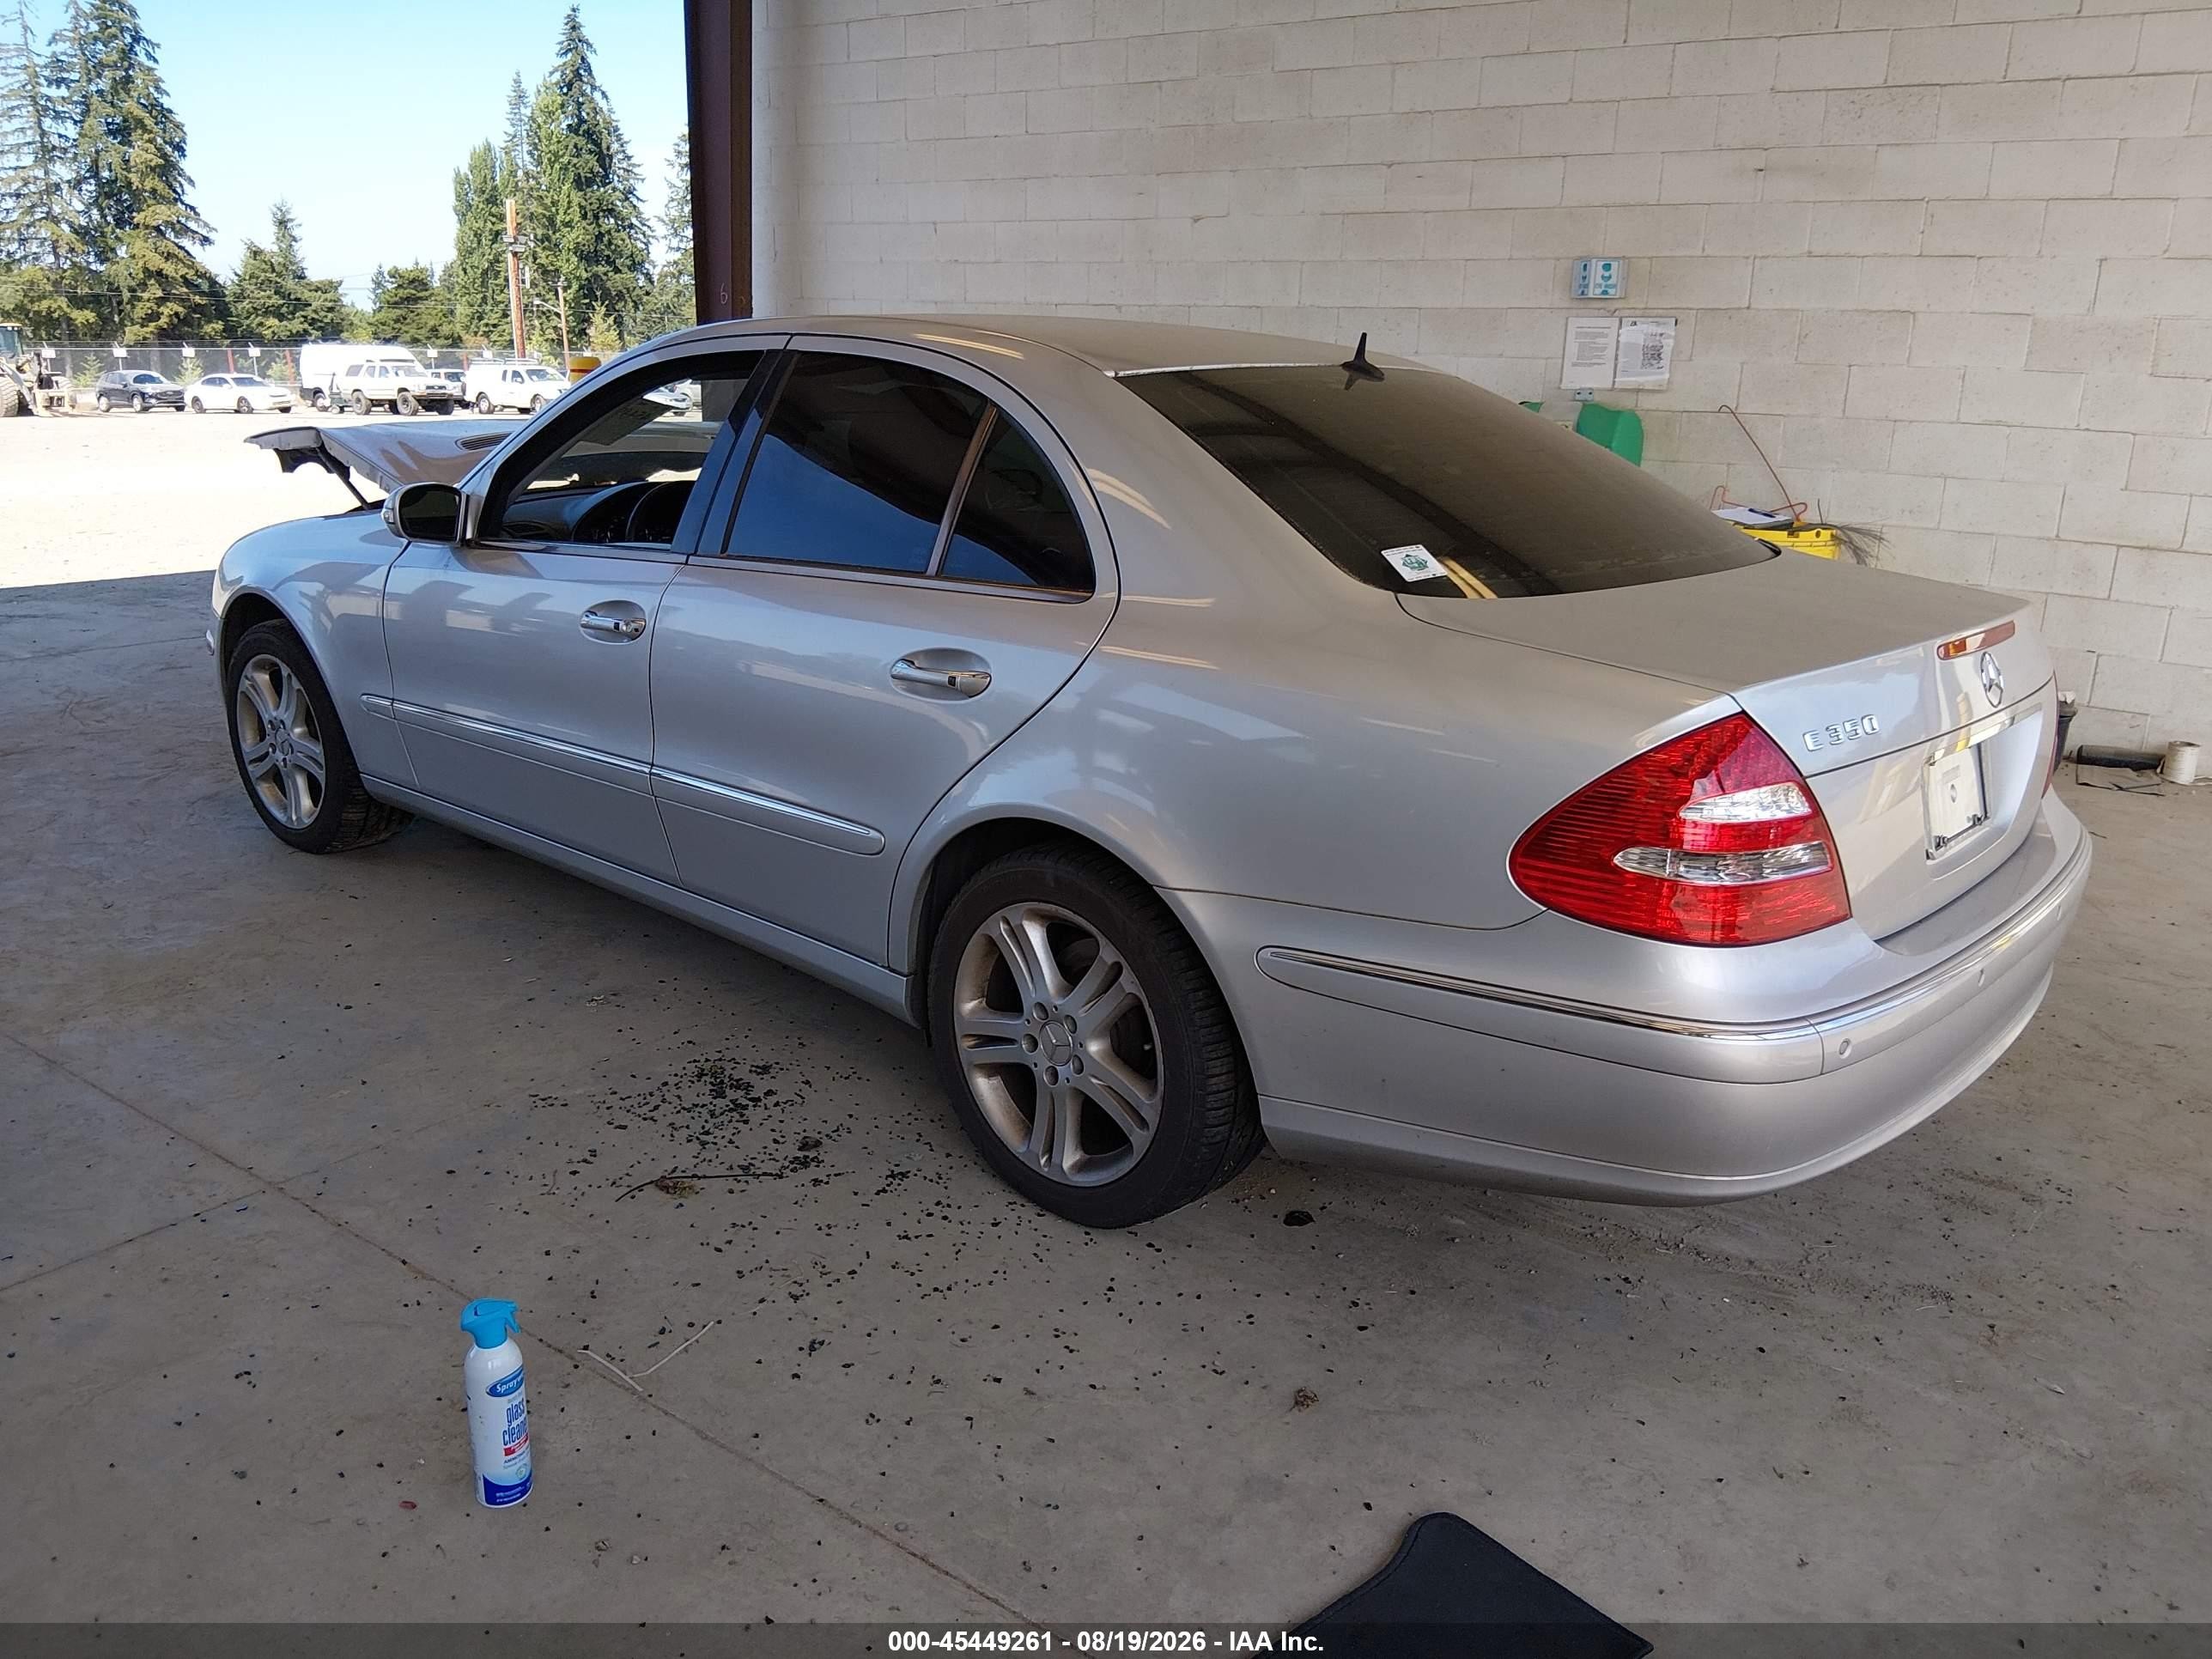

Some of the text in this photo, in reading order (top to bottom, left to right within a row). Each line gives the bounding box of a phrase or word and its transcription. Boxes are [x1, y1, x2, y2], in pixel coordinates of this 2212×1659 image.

[1802, 714, 1880, 752] E 350
[506, 1397, 526, 1427] glass
